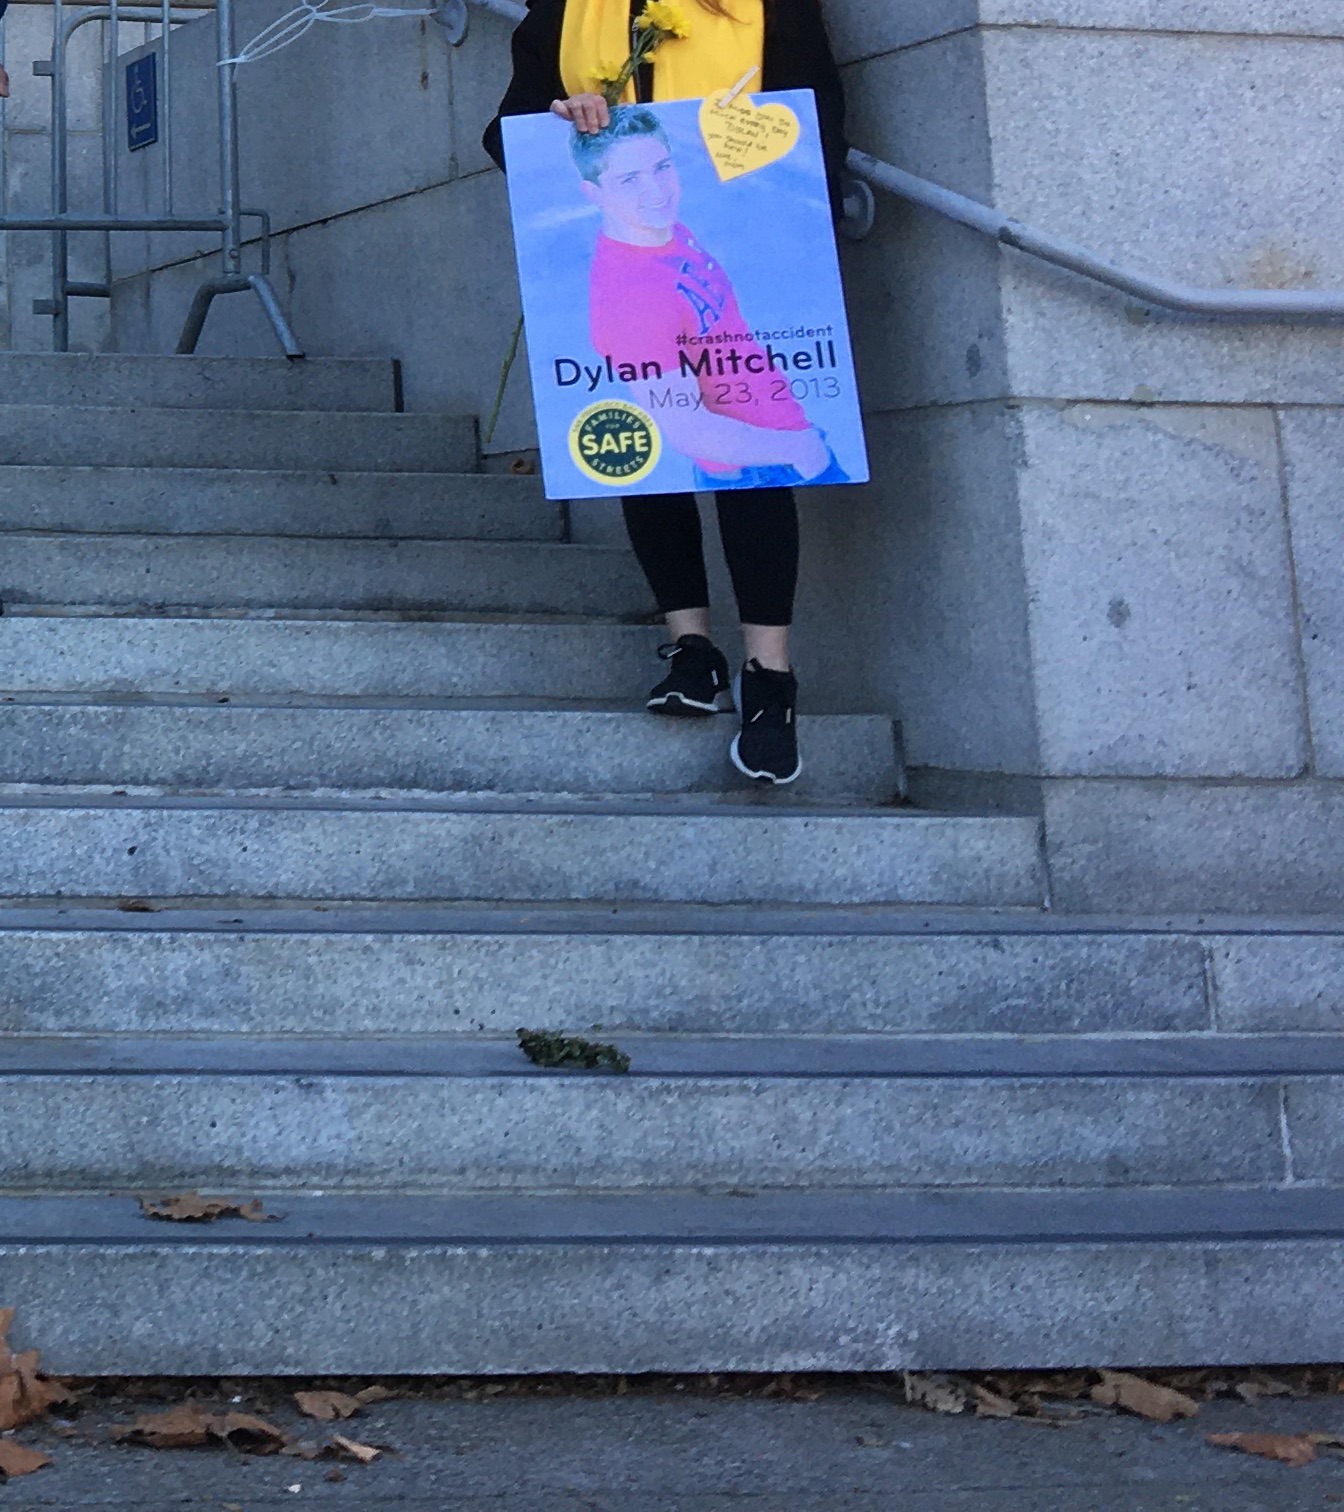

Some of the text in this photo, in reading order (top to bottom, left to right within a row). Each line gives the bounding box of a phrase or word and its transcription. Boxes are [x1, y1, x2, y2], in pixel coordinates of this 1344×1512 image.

[674, 324, 834, 347] #crashnotaccident
[553, 339, 838, 393] Dylan Mitchell
[648, 375, 842, 412] May 23, 2013
[581, 431, 649, 456] SAFE
